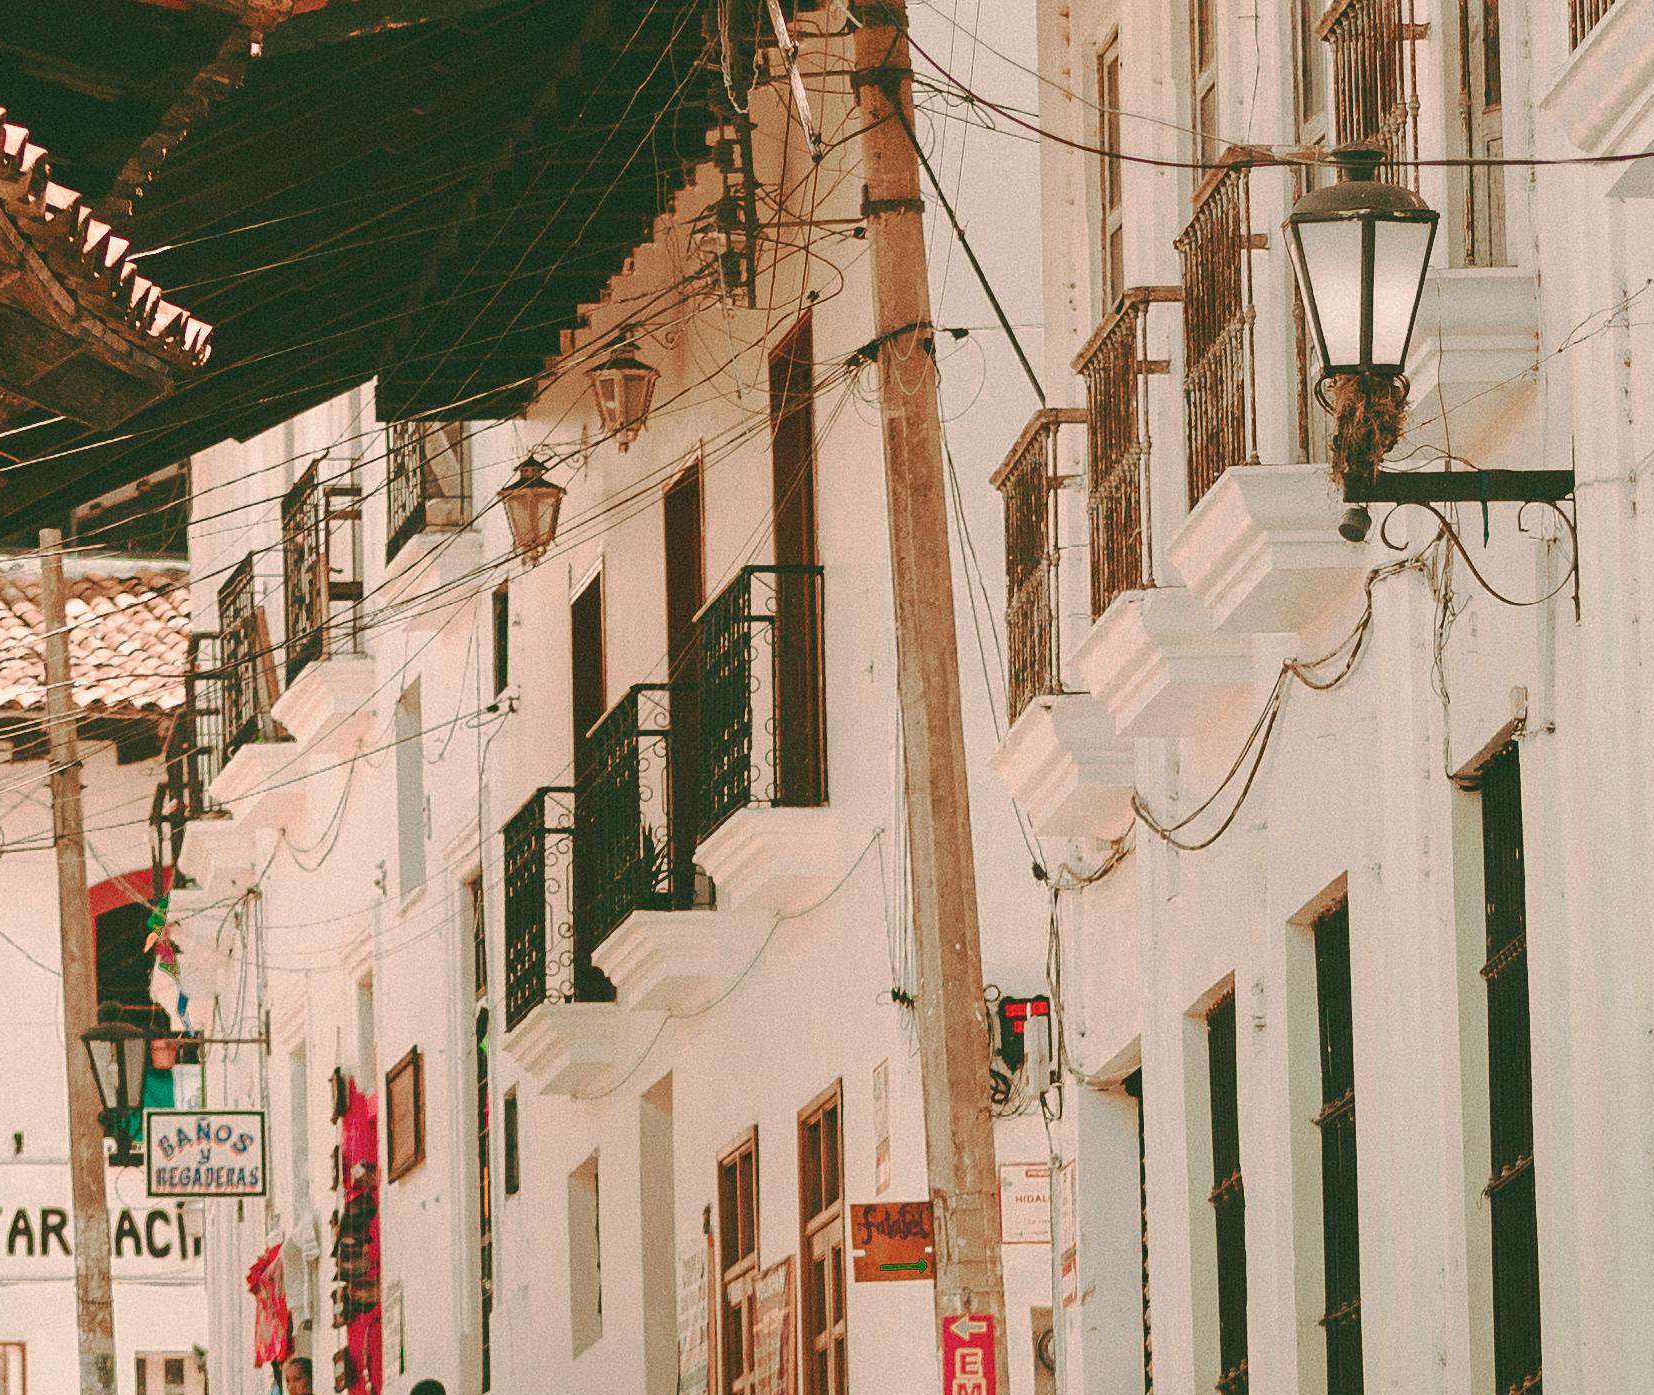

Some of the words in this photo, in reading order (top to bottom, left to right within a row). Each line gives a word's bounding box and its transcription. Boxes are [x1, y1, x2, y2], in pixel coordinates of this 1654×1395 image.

[157, 1116, 254, 1159] BAÑOS
[155, 1166, 260, 1188] REGADERAS
[1015, 1194, 1048, 1204] HIDAL
